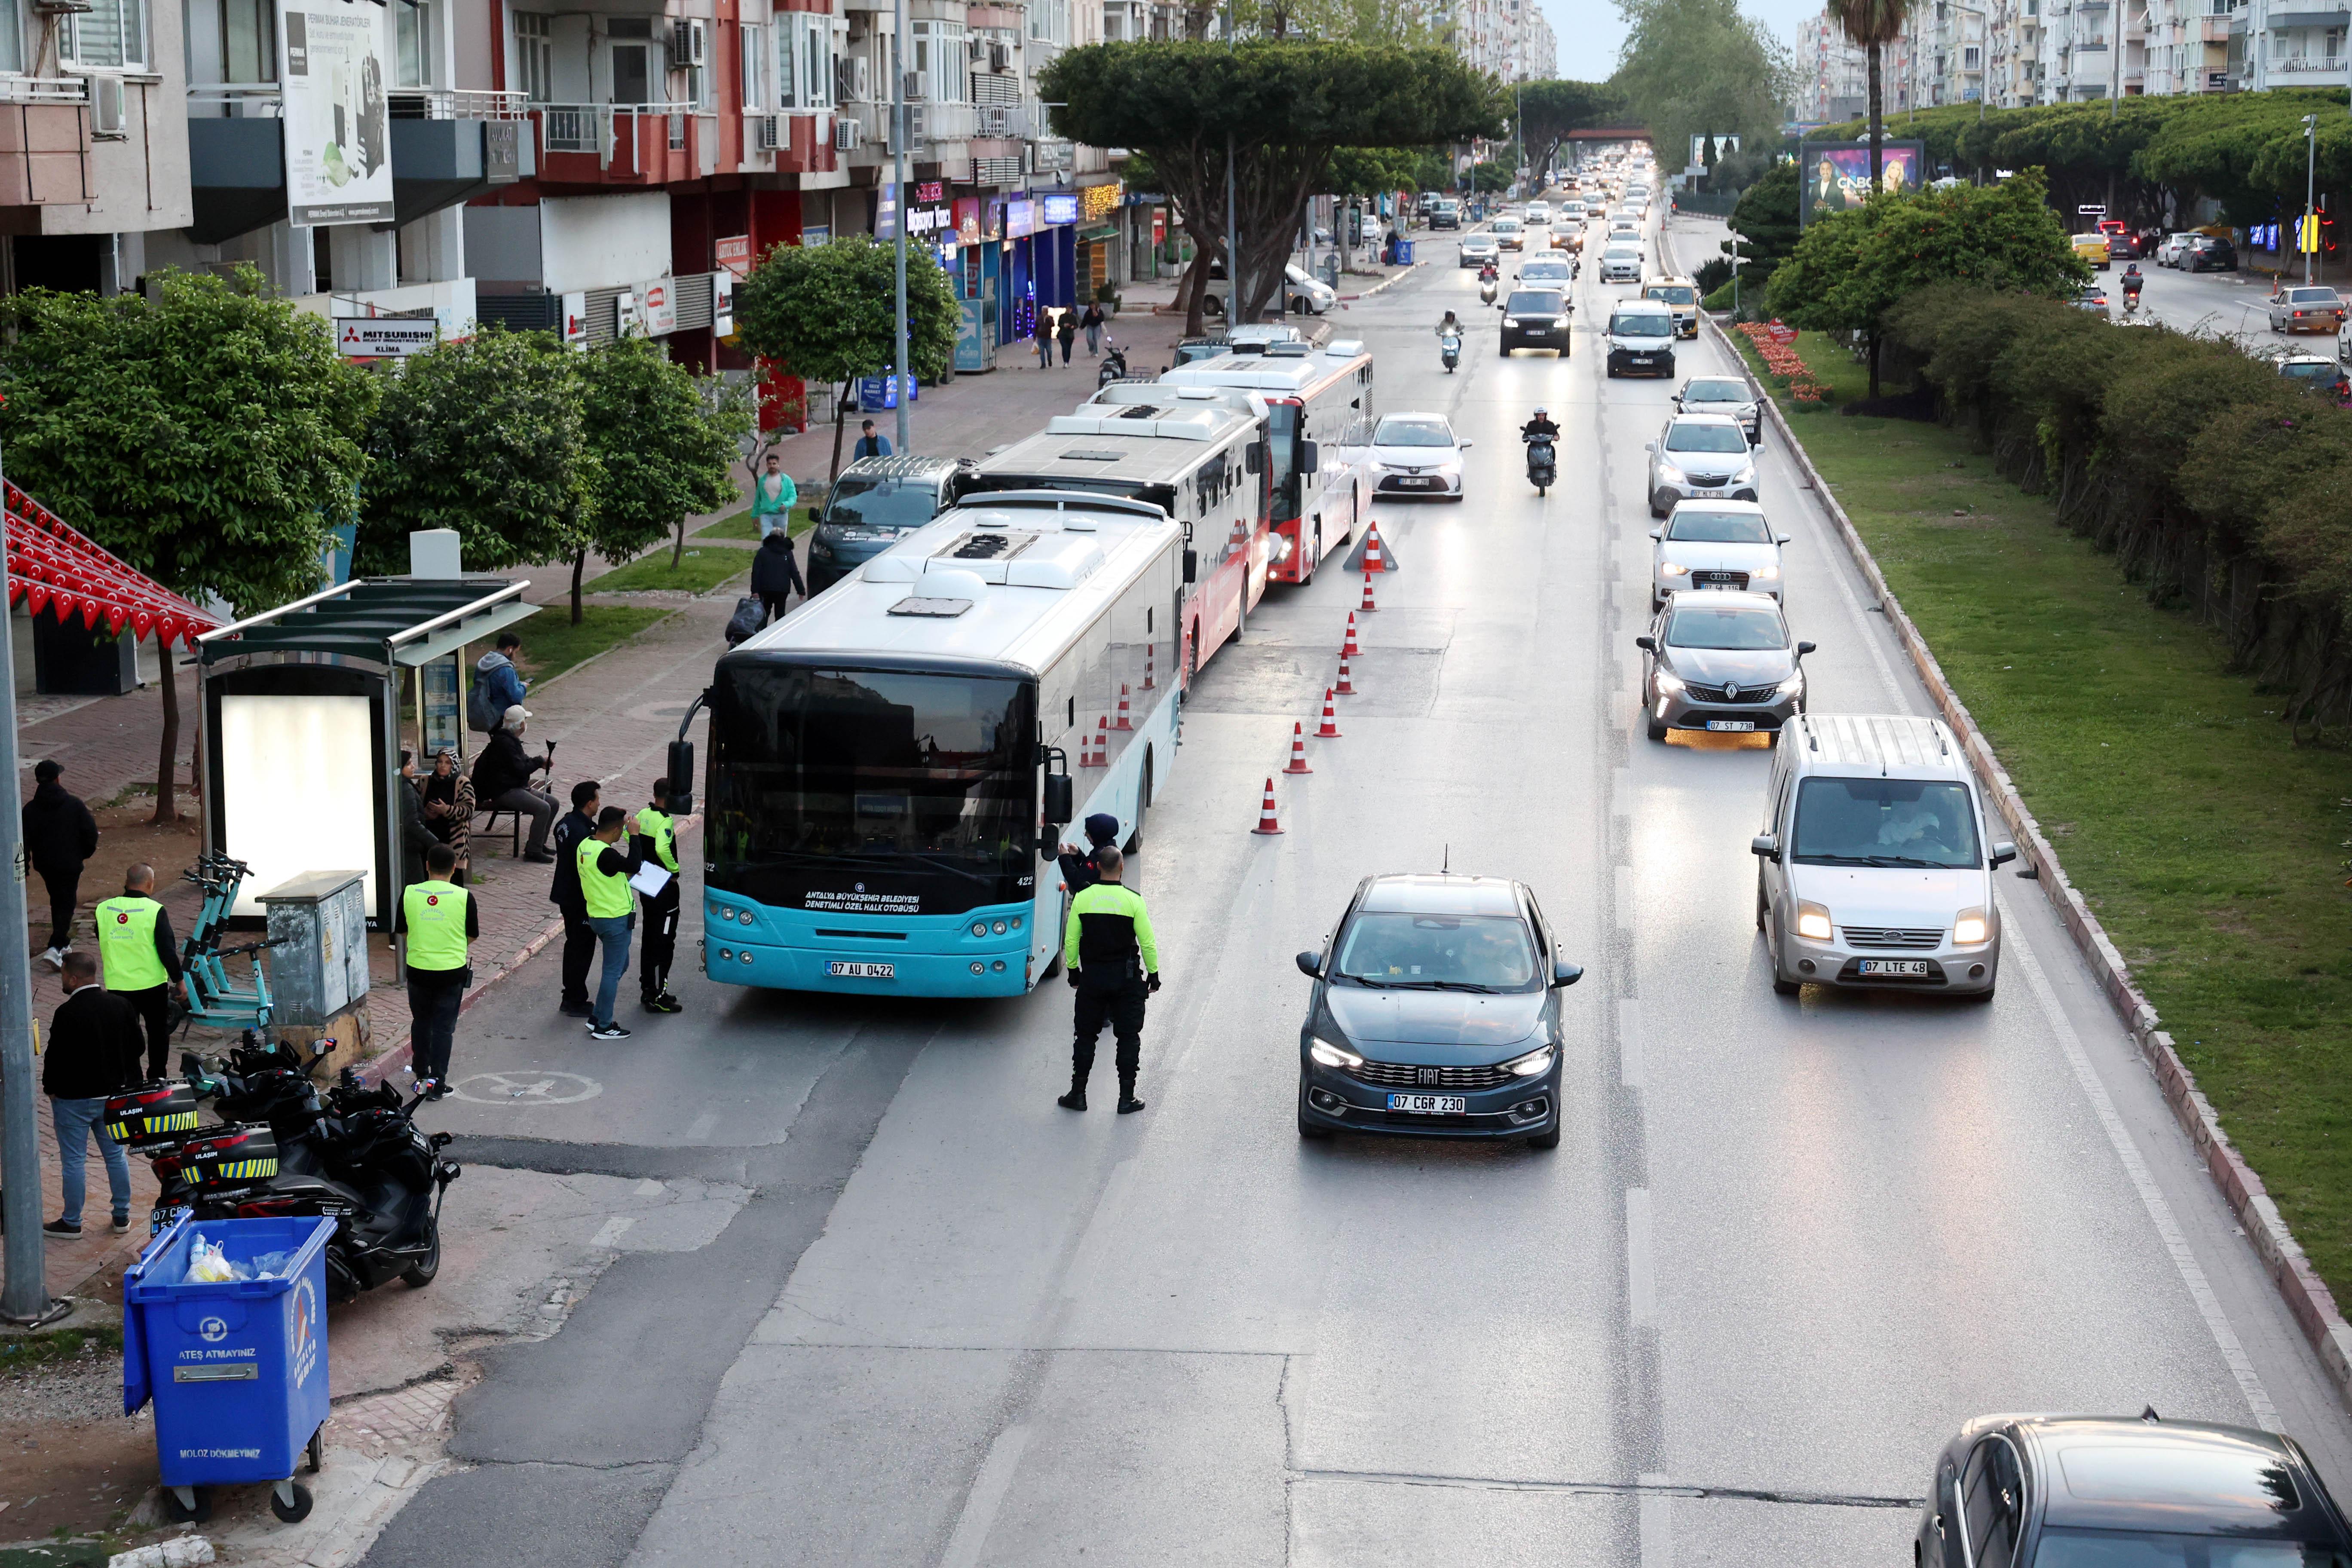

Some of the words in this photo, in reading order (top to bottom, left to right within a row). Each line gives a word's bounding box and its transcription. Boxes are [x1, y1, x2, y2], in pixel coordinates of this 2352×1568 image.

[491, 126, 512, 141] AVUKAT
[907, 206, 934, 237] Bilgisayar
[375, 344, 400, 353] KLİMA
[1711, 722, 1719, 730] 07
[1725, 722, 1733, 730] ST
[704, 861, 715, 872] 22
[1016, 876, 1033, 886] 422
[805, 891, 835, 900] ANTALYA
[836, 892, 880, 903] BÜYÜKŞEHİR
[880, 894, 920, 903] BELEDİYESİ
[805, 900, 844, 910] DENETİMLİ
[844, 901, 863, 911] ÖZEL
[864, 903, 884, 912] HALK
[883, 904, 920, 913] OTOBÜSÜ
[831, 963, 844, 974] 07
[848, 964, 861, 975] AU
[867, 965, 893, 977] 0422
[1865, 962, 1879, 972] 07
[1886, 962, 1906, 972] LTE
[1912, 962, 1926, 973] 48
[1418, 1068, 1440, 1085] FIAT
[1394, 1095, 1408, 1108] 07
[1414, 1096, 1436, 1110] CGR
[1441, 1098, 1463, 1111] 230
[119, 1107, 143, 1116] ULAŞIM
[195, 1151, 218, 1160] ULAŞIM
[153, 1210, 166, 1221] 07
[179, 1350, 203, 1361] ATEŞ
[205, 1348, 256, 1359] ATMAYINIZ
[180, 1449, 208, 1458] MOLOZ
[210, 1447, 261, 1459] DÖKMEYİNİZ
